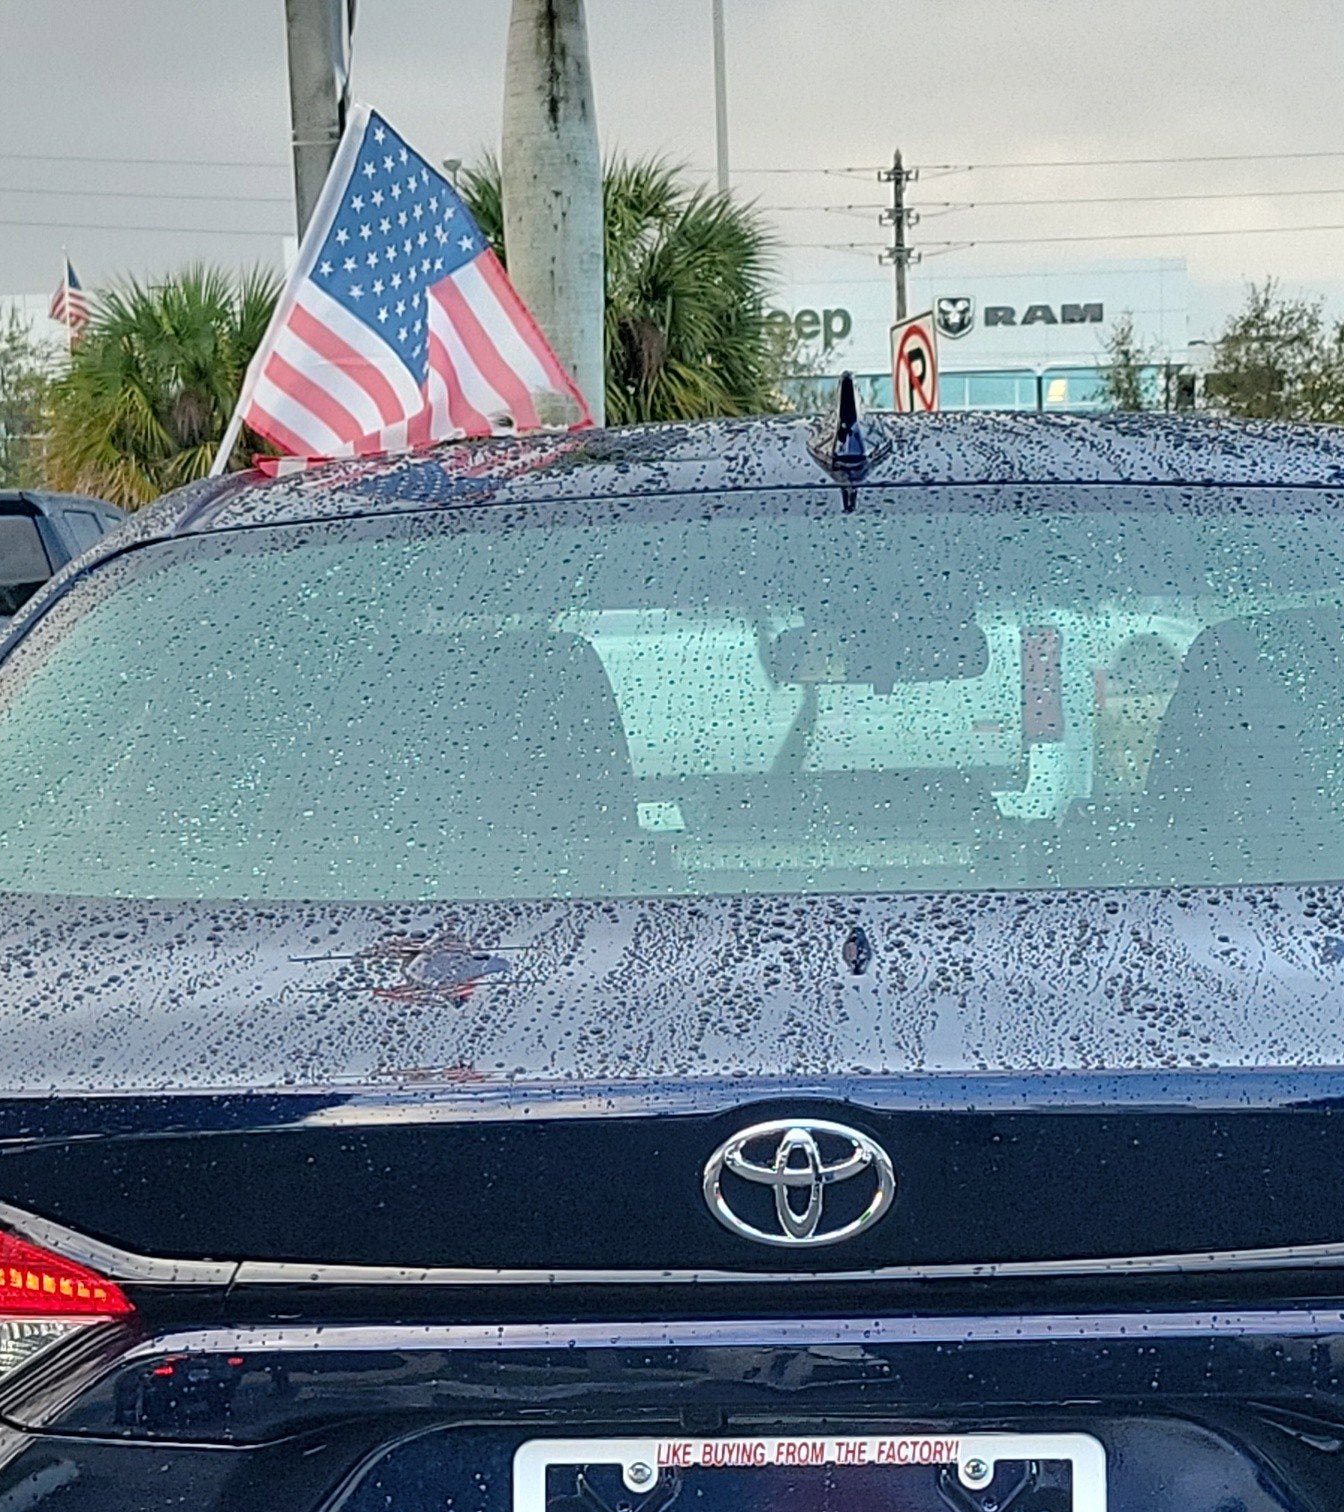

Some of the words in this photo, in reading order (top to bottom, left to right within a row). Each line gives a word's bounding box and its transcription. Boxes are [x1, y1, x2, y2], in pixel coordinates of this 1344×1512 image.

[983, 302, 1104, 327] RAM
[765, 308, 854, 351] eep
[656, 1443, 692, 1467] LIKE
[701, 1442, 766, 1465] BUYING
[775, 1442, 825, 1464] FROM
[835, 1441, 868, 1463] THE
[877, 1440, 960, 1463] FACTORY!
